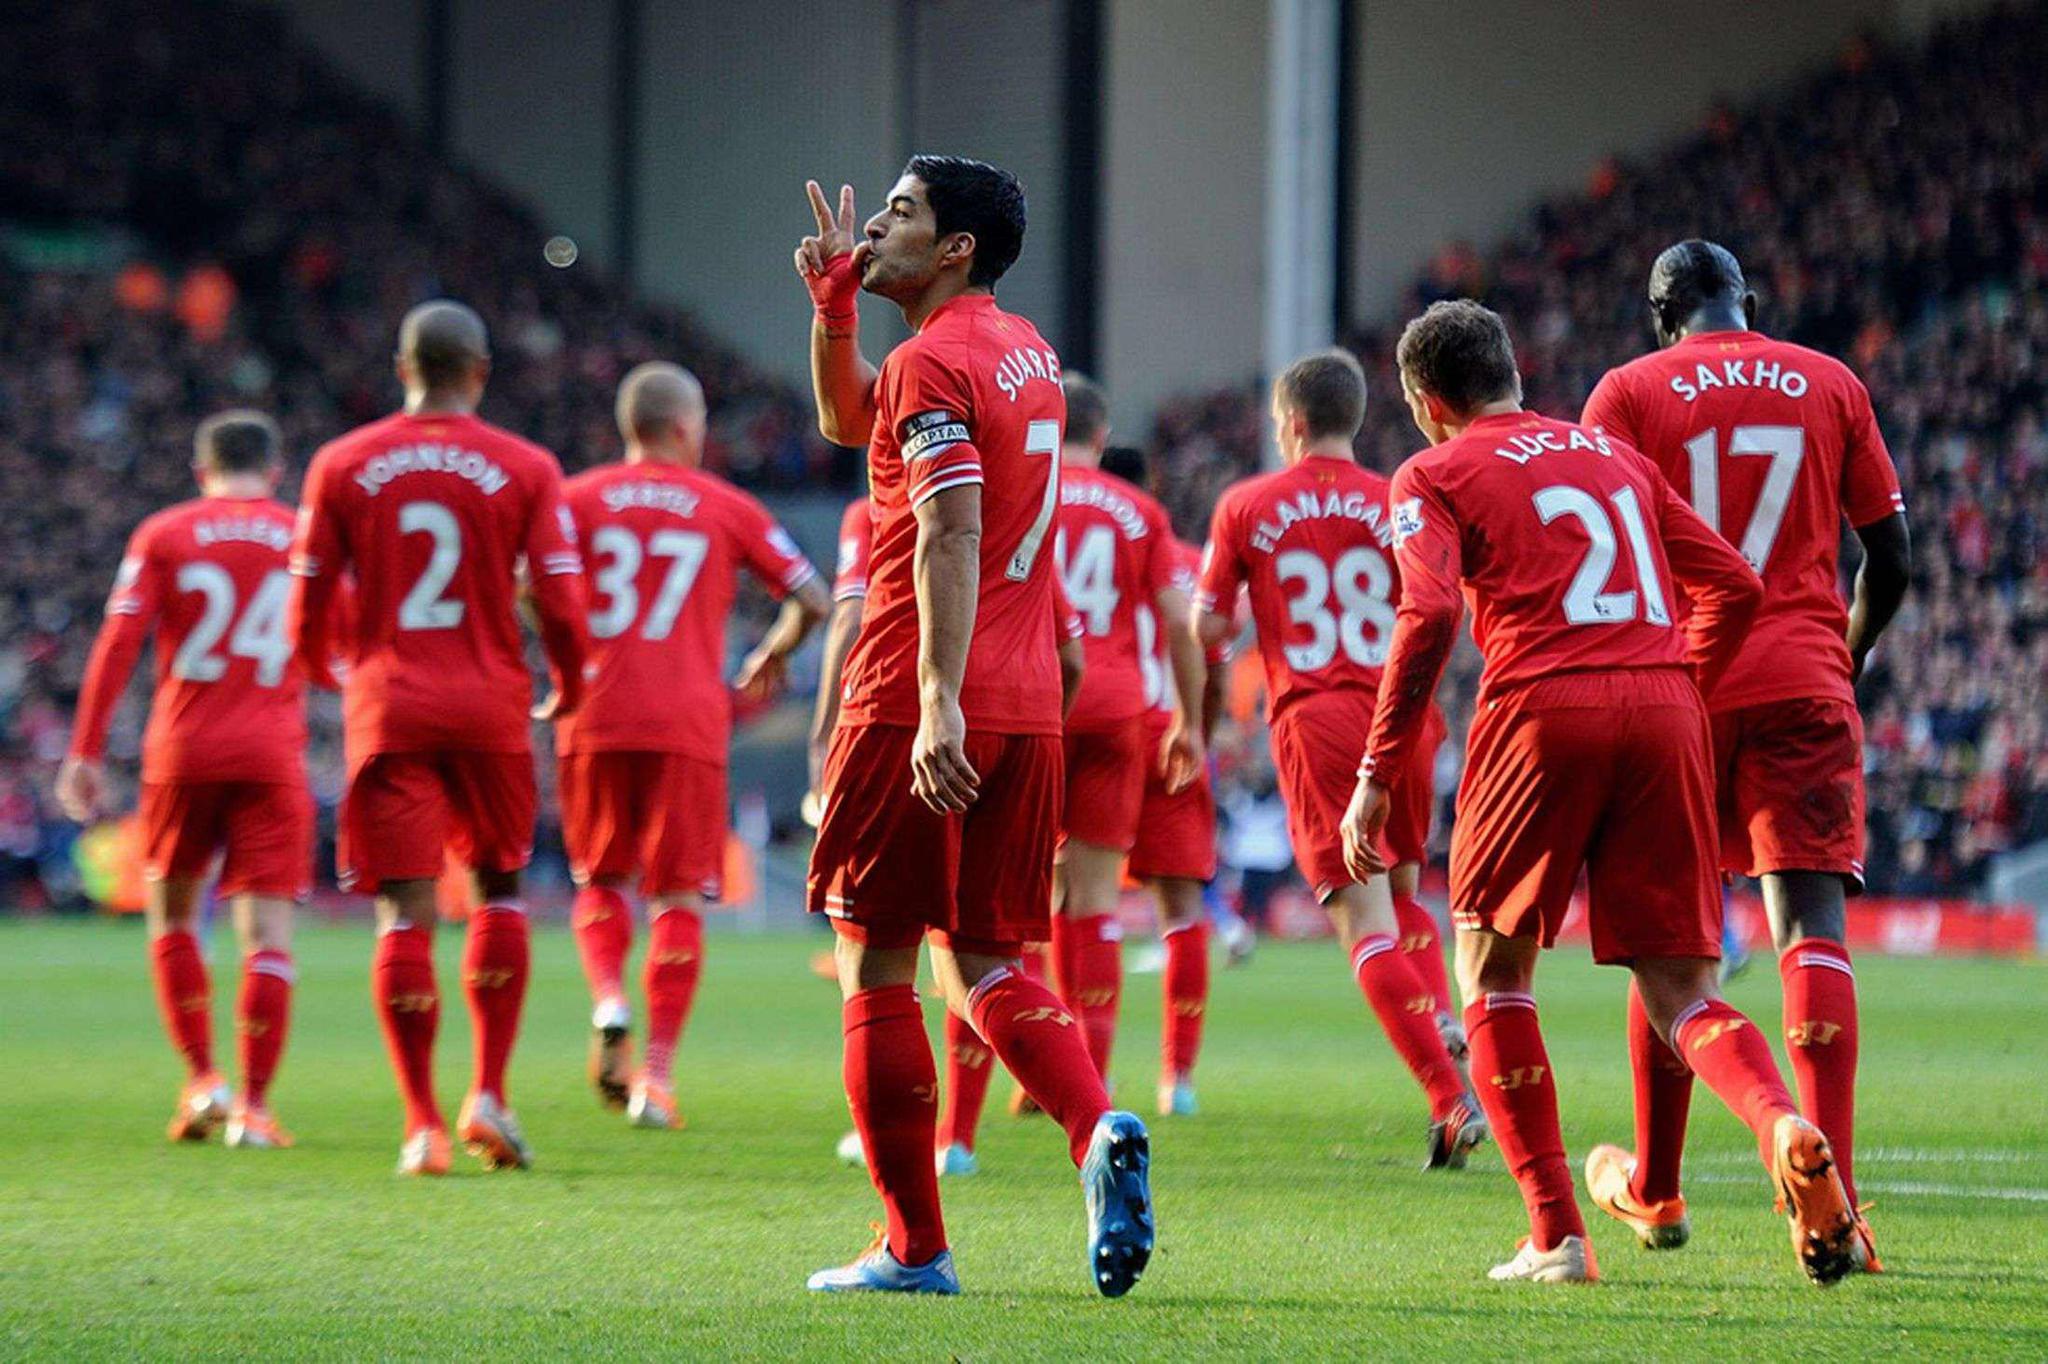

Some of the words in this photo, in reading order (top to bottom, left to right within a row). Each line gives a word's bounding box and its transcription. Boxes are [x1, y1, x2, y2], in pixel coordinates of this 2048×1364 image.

[996, 347, 1065, 402] SUARE
[1671, 359, 1808, 402] SAKHO
[354, 443, 511, 496] JOHNSON
[1004, 420, 1060, 583] 7
[1494, 426, 1613, 464] LUCAS
[1683, 425, 1805, 575] 17
[398, 501, 466, 630] 2
[1252, 490, 1393, 554] FLANAGAN
[1531, 484, 1673, 627] 21
[171, 561, 295, 688] 24
[588, 525, 709, 641] 37
[1276, 548, 1397, 672] 38
